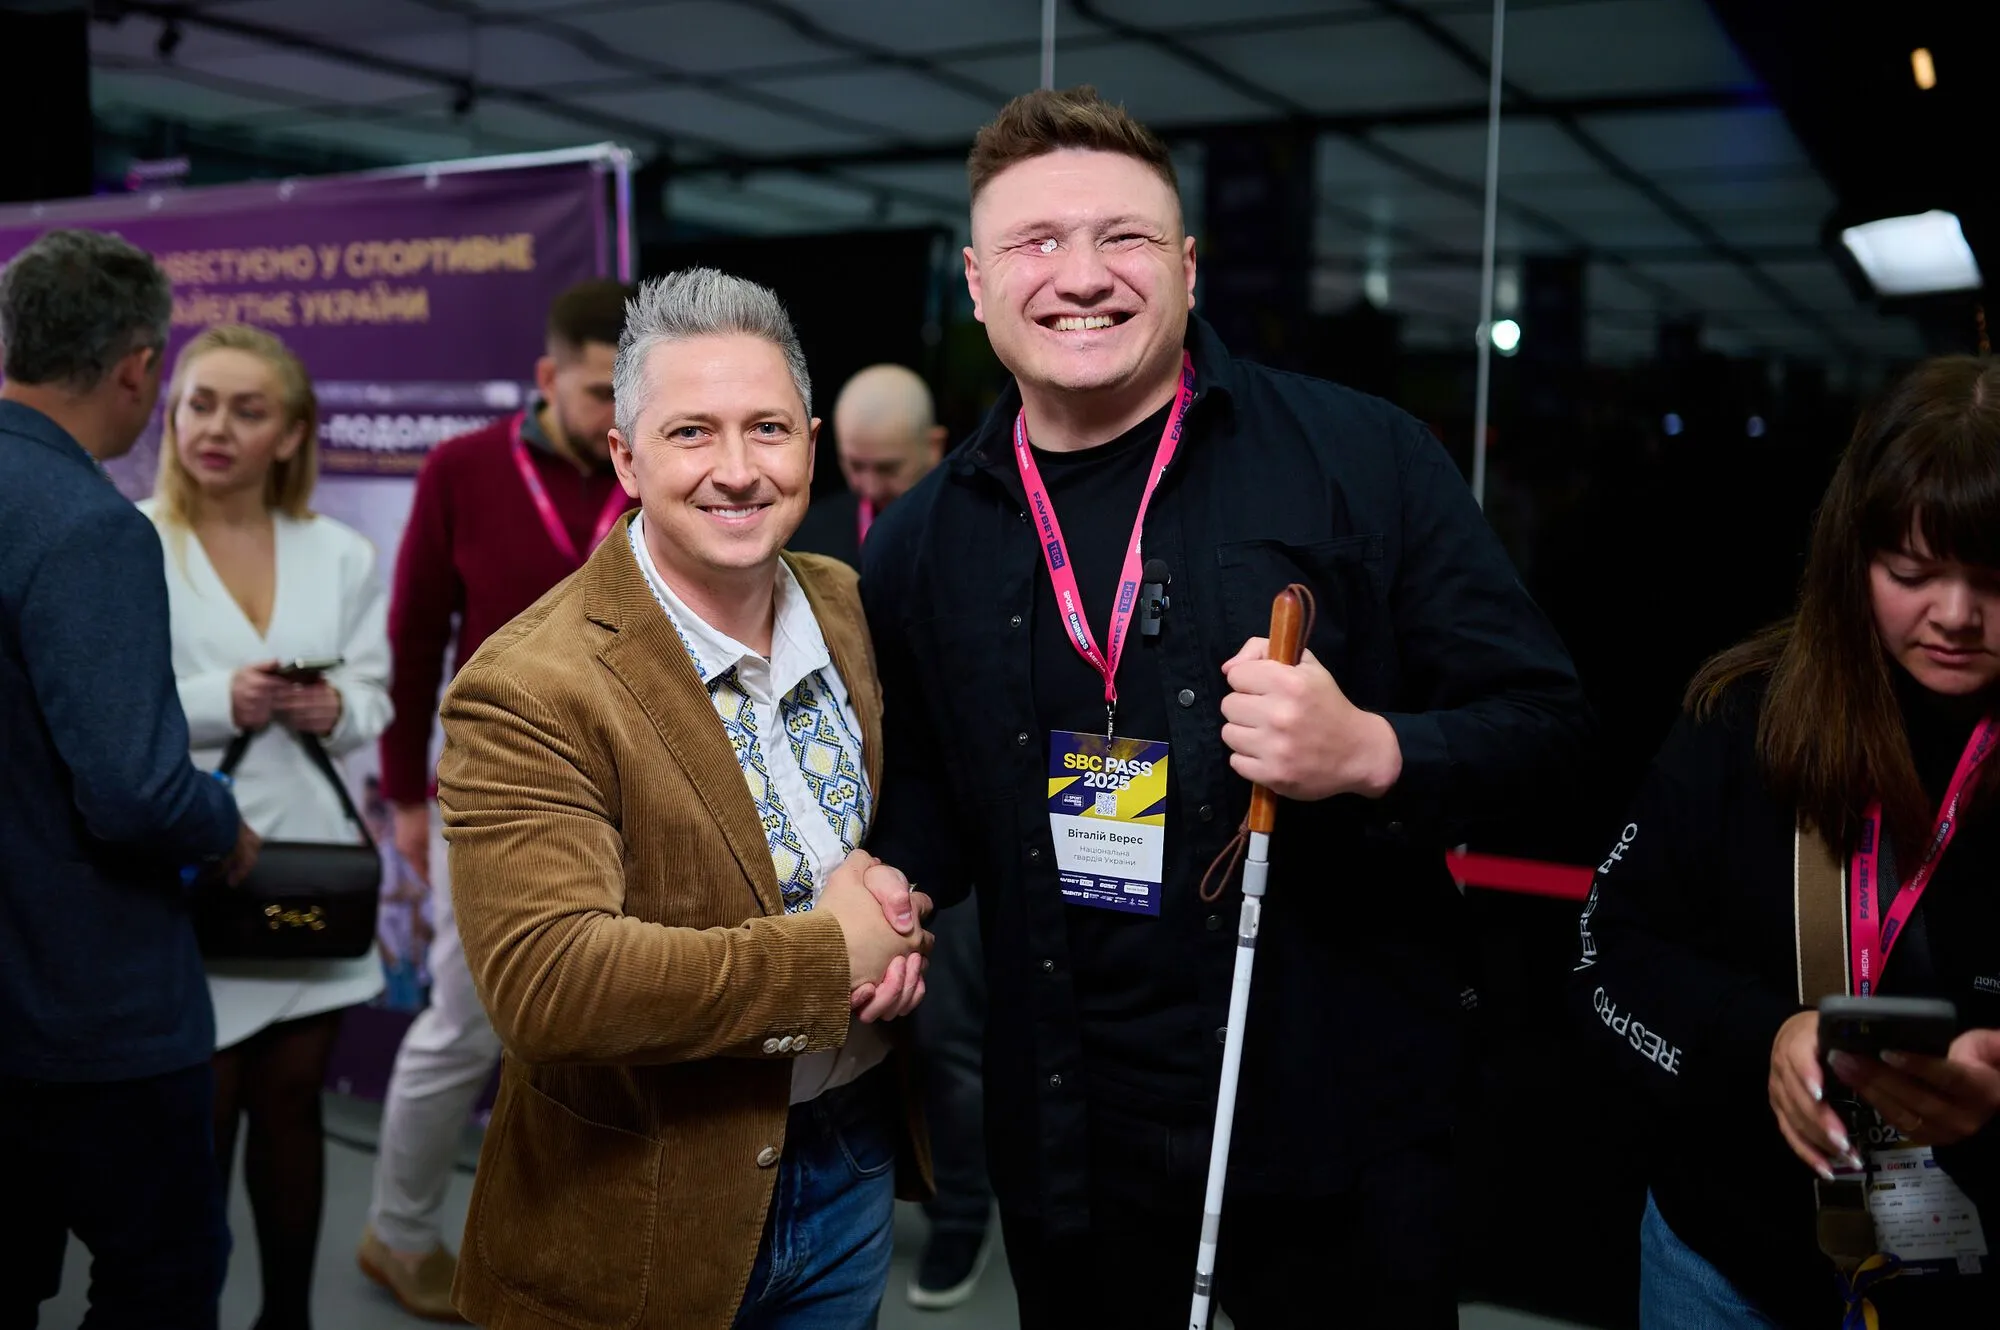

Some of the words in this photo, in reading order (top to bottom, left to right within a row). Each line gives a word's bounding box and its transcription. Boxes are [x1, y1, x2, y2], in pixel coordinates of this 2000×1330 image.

[344, 233, 535, 277] СПОРТИВНЕ
[301, 281, 430, 326] УКРАЇНИ
[1033, 491, 1055, 539] FAVBET
[1049, 542, 1063, 568] TECH
[1064, 590, 1075, 613] SPORT
[1120, 583, 1134, 611] TECH
[1069, 612, 1089, 650] BUSINESS
[1063, 753, 1103, 772] SBC
[1105, 757, 1153, 777] PASS
[1084, 771, 1131, 791] 2025
[1068, 828, 1106, 841] Віталій
[1109, 833, 1144, 845] Верес
[1597, 823, 1638, 874] PRO
[1074, 854, 1103, 863] гвардія
[1104, 857, 1136, 866] України
[1080, 845, 1130, 857] Національна
[1860, 857, 1870, 920] FAVBET
